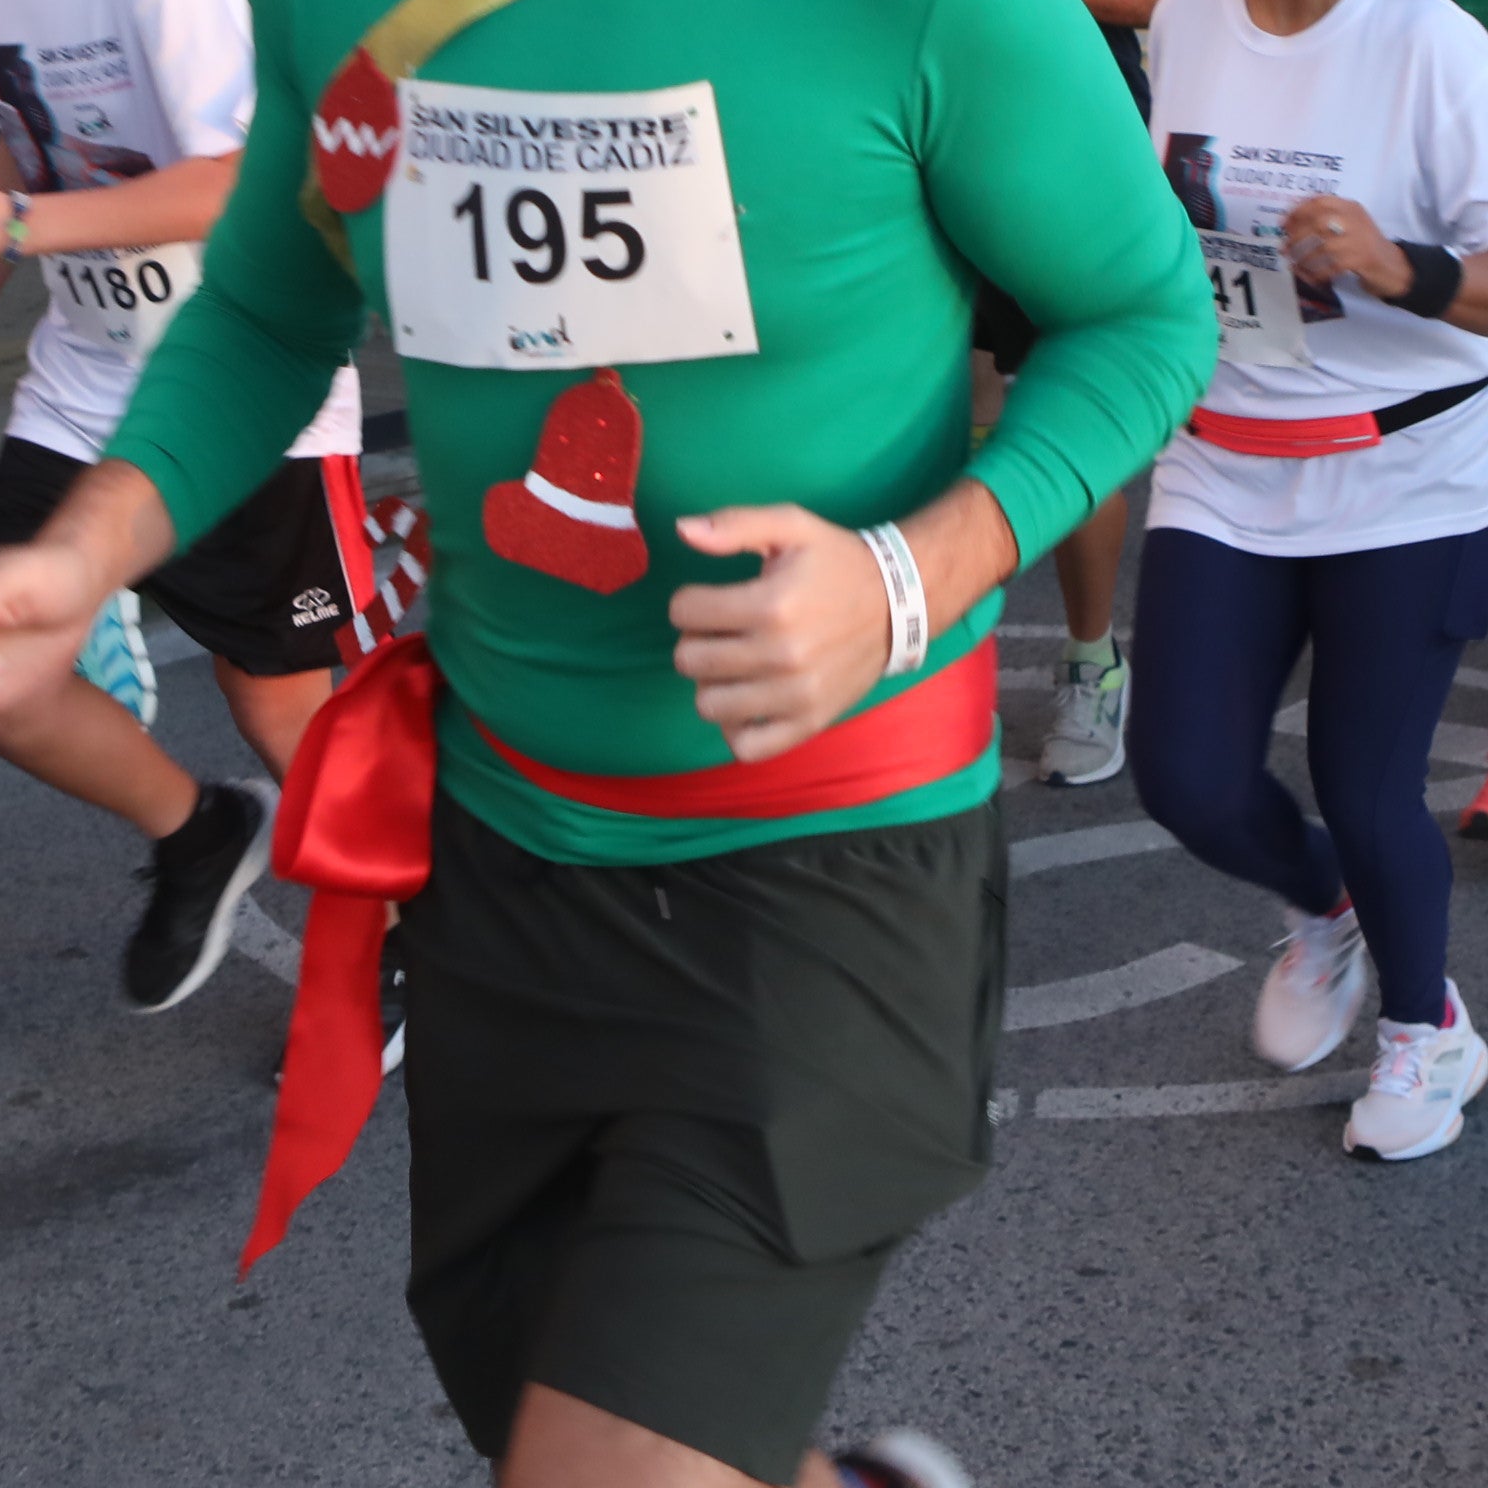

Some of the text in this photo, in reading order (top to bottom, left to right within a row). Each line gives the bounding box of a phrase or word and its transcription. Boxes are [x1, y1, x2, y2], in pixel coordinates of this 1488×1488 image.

[410, 105, 689, 140] SAN SILVESTRE
[408, 131, 510, 169] CIUDAD
[521, 142, 565, 172] DE
[453, 182, 645, 284] 195
[59, 260, 171, 310] 1180
[292, 602, 341, 628] KELME
